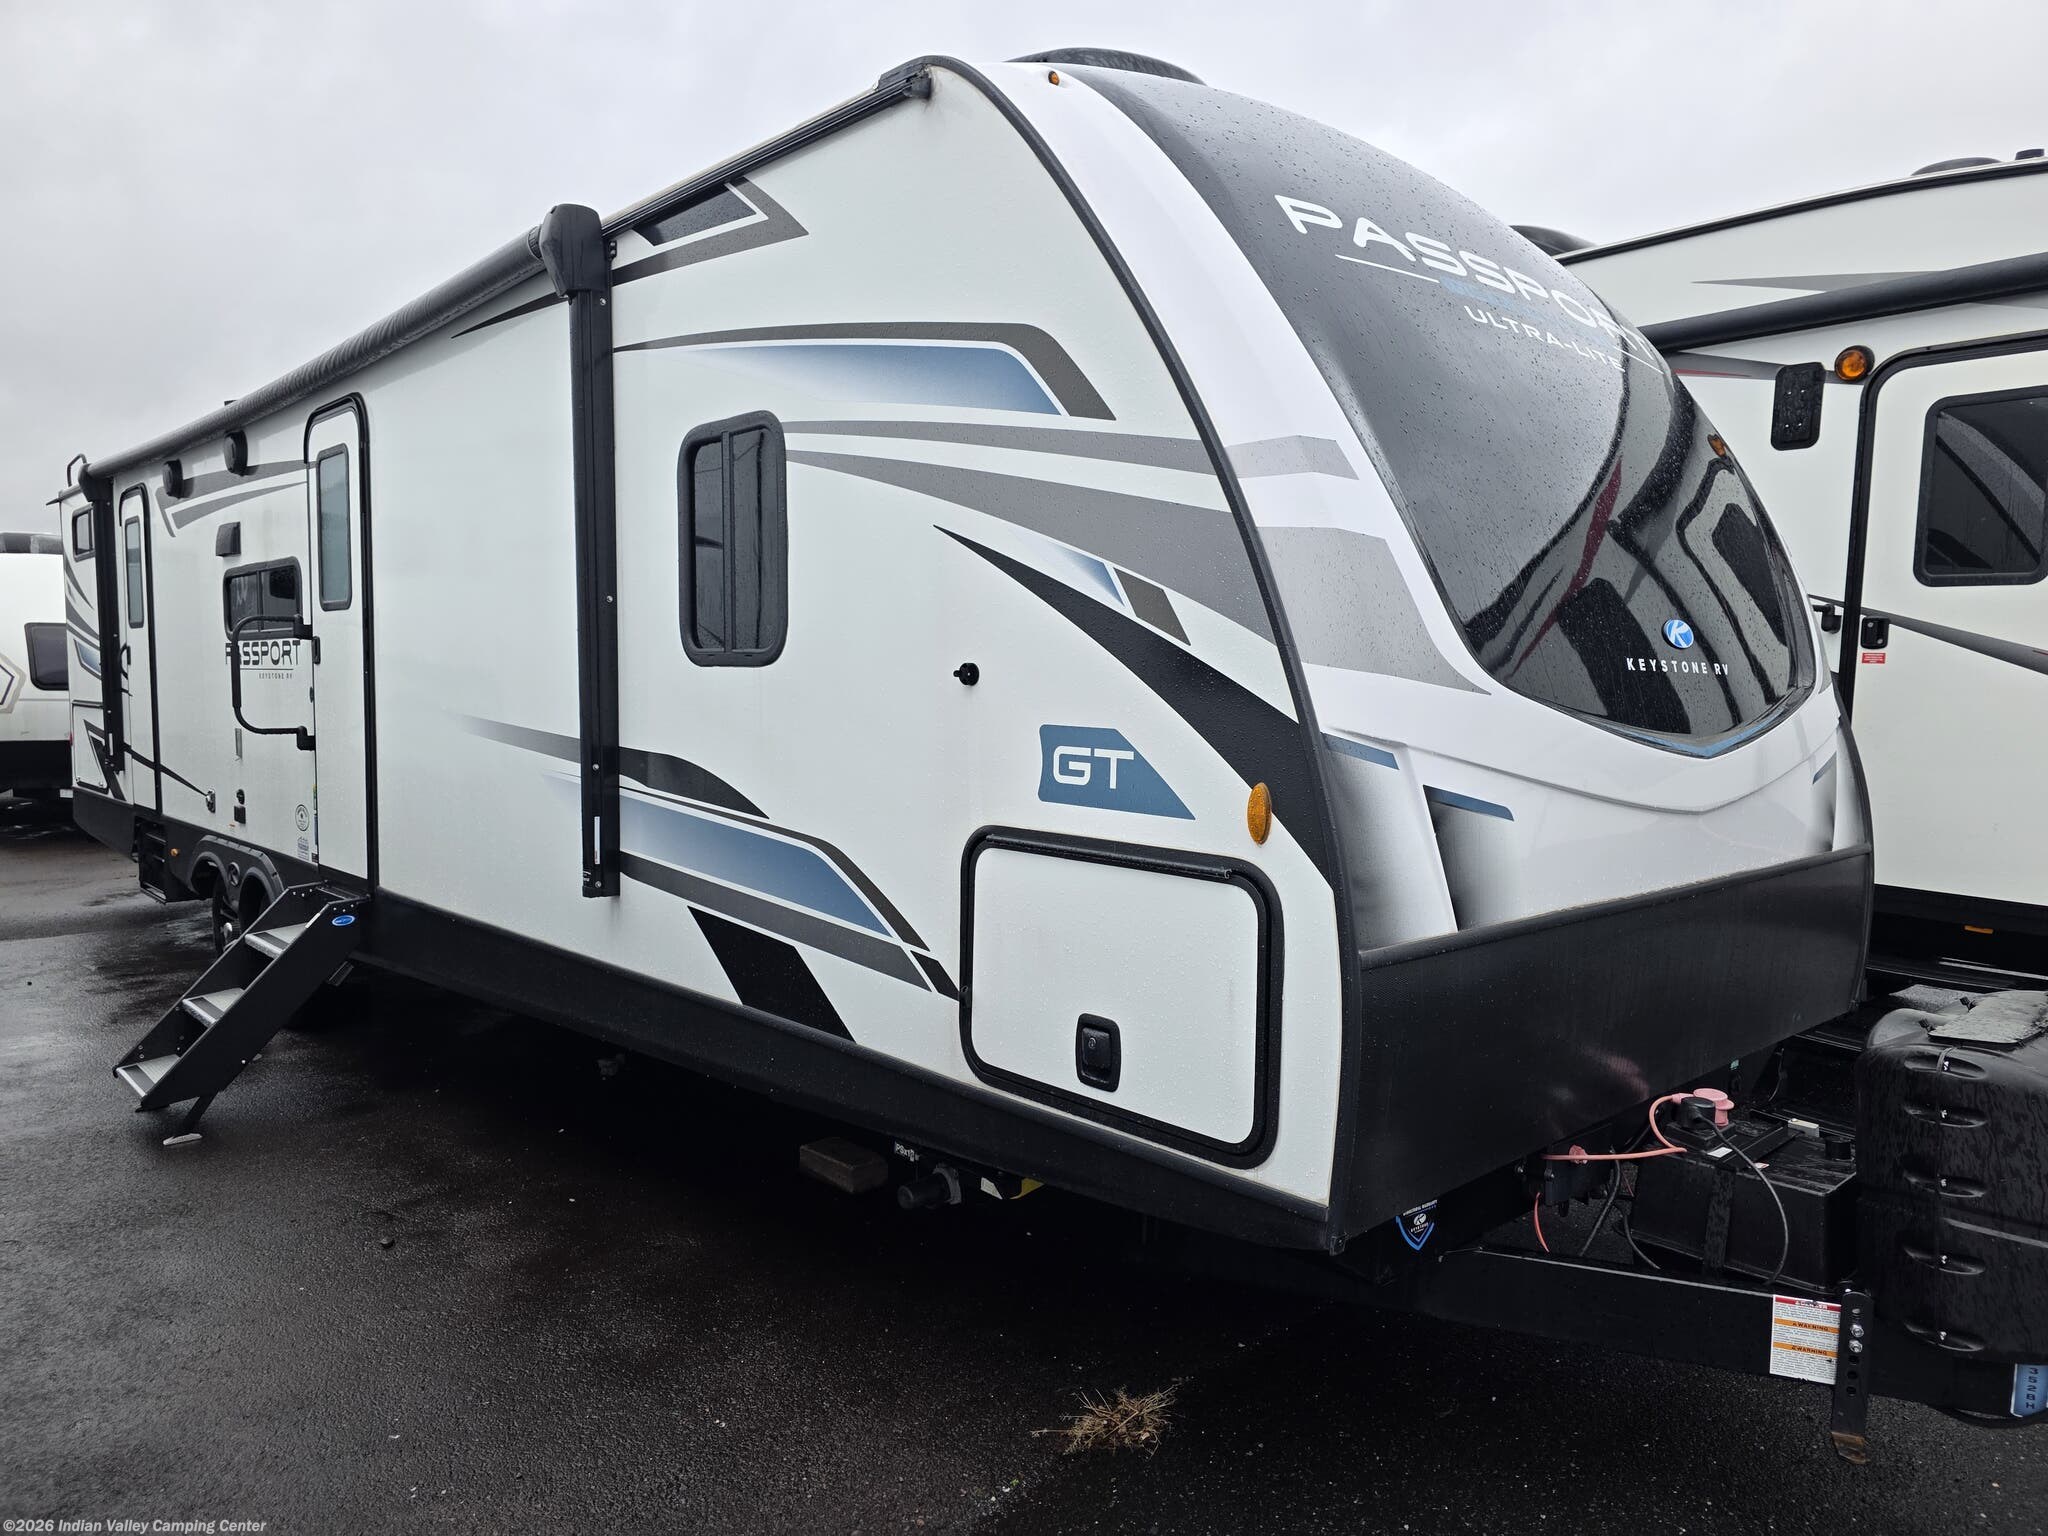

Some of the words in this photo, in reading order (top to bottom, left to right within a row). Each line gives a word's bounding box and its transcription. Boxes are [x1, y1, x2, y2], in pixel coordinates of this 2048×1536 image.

[1275, 194, 1655, 362] PASSPORT
[1464, 305, 1626, 373] ULTRA-LITE
[225, 640, 300, 665] PSSPORT
[1626, 657, 1708, 674] KEYSTONE
[1714, 663, 1729, 676] RV
[1053, 745, 1135, 790] GT
[1797, 1321, 1829, 1332] WARNING
[1797, 1346, 1828, 1356] WARNING
